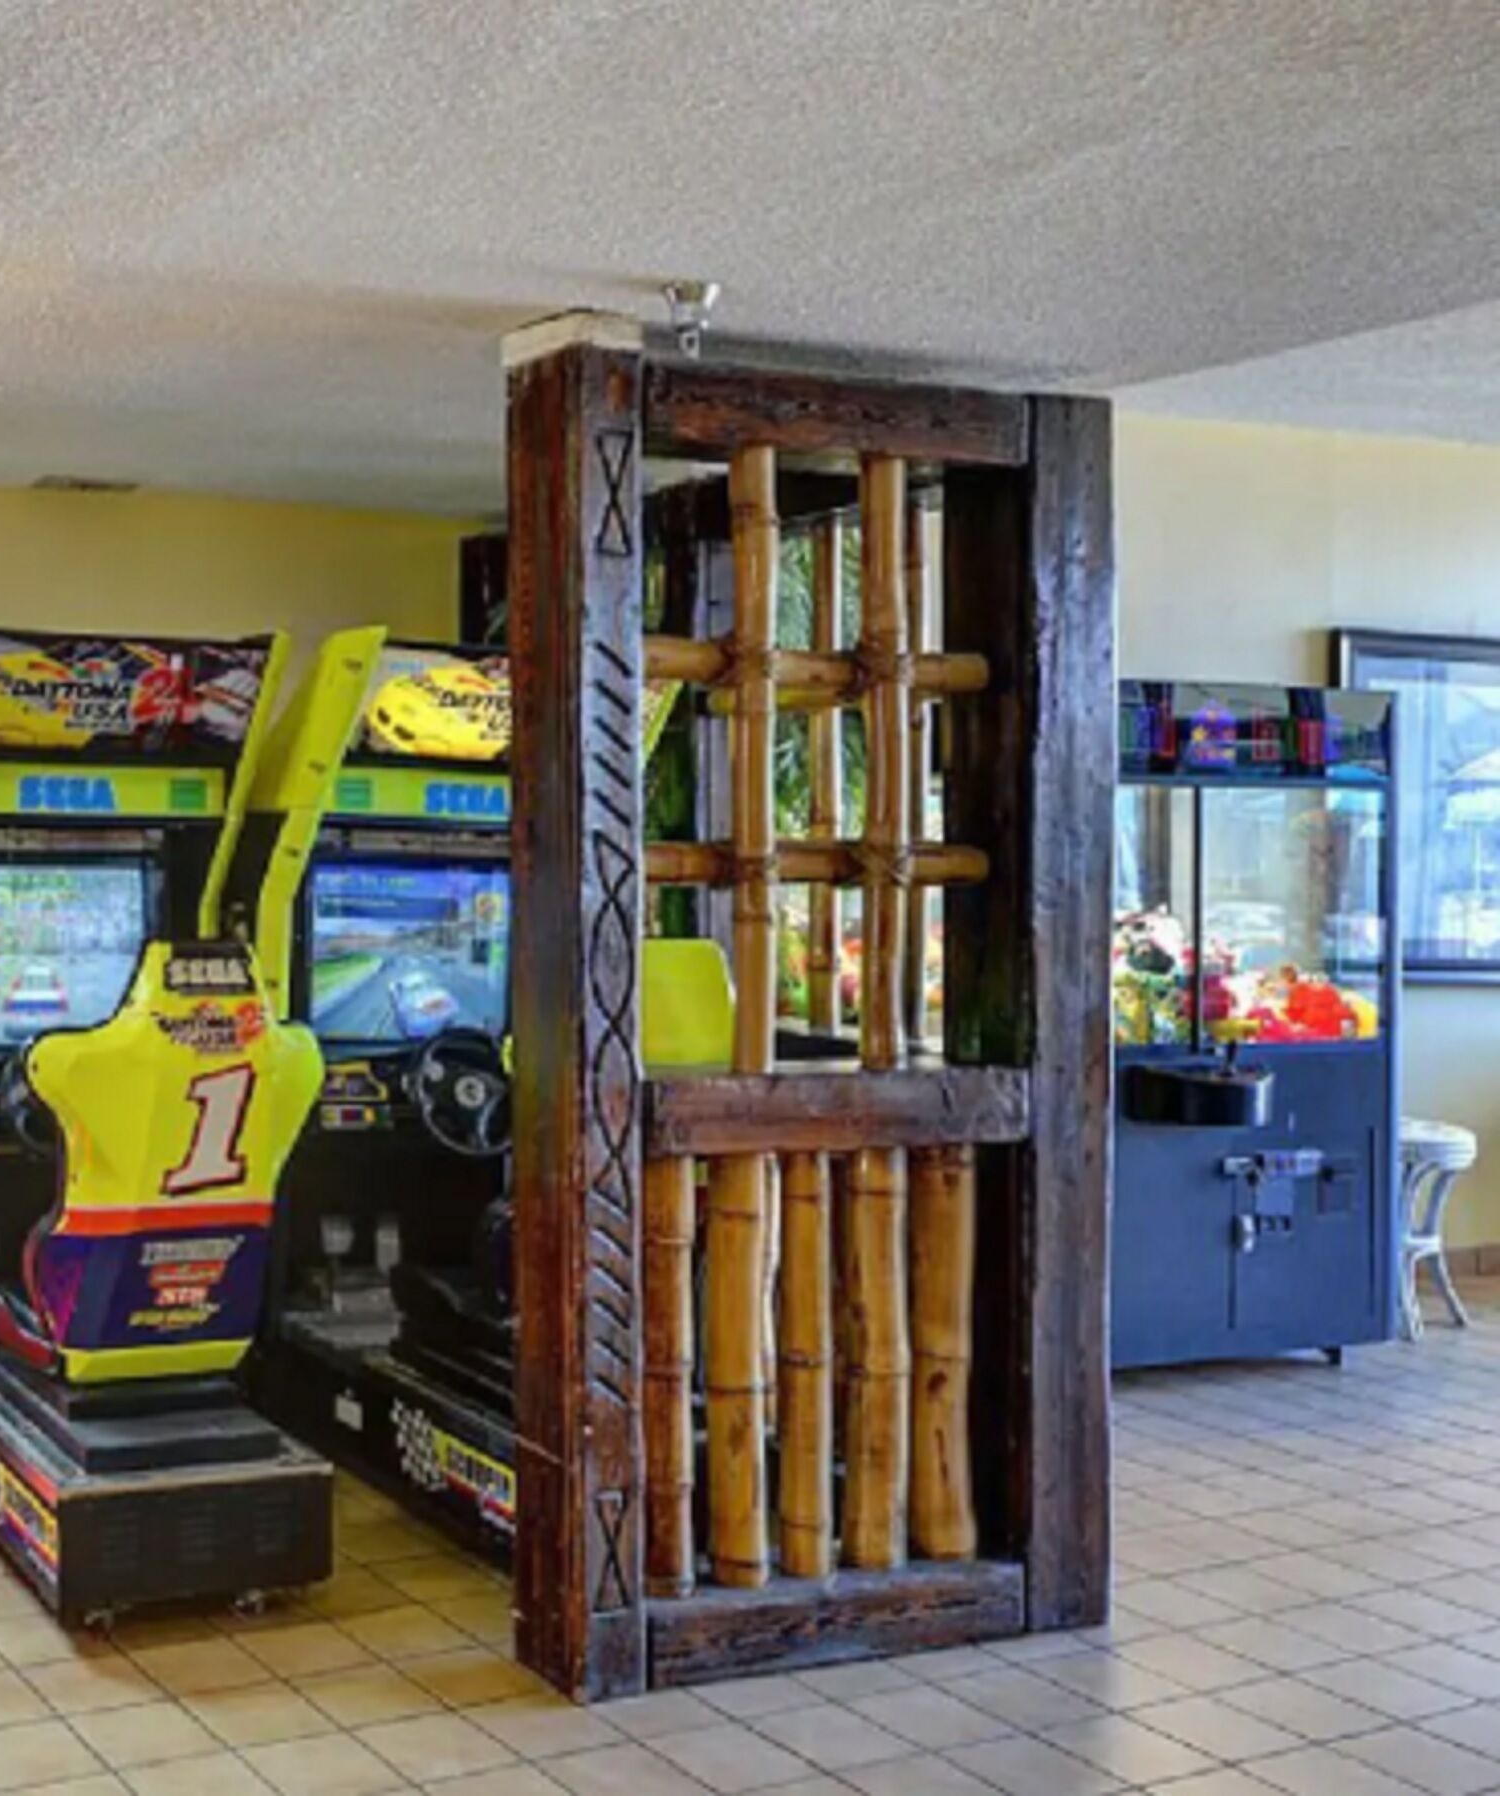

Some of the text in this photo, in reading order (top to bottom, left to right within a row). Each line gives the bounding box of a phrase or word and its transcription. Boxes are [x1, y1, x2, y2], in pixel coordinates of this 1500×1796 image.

[11, 680, 131, 701] DAYTONA
[18, 775, 117, 811] SEGA
[167, 957, 248, 986] SEGA
[160, 1061, 256, 1198] 1
